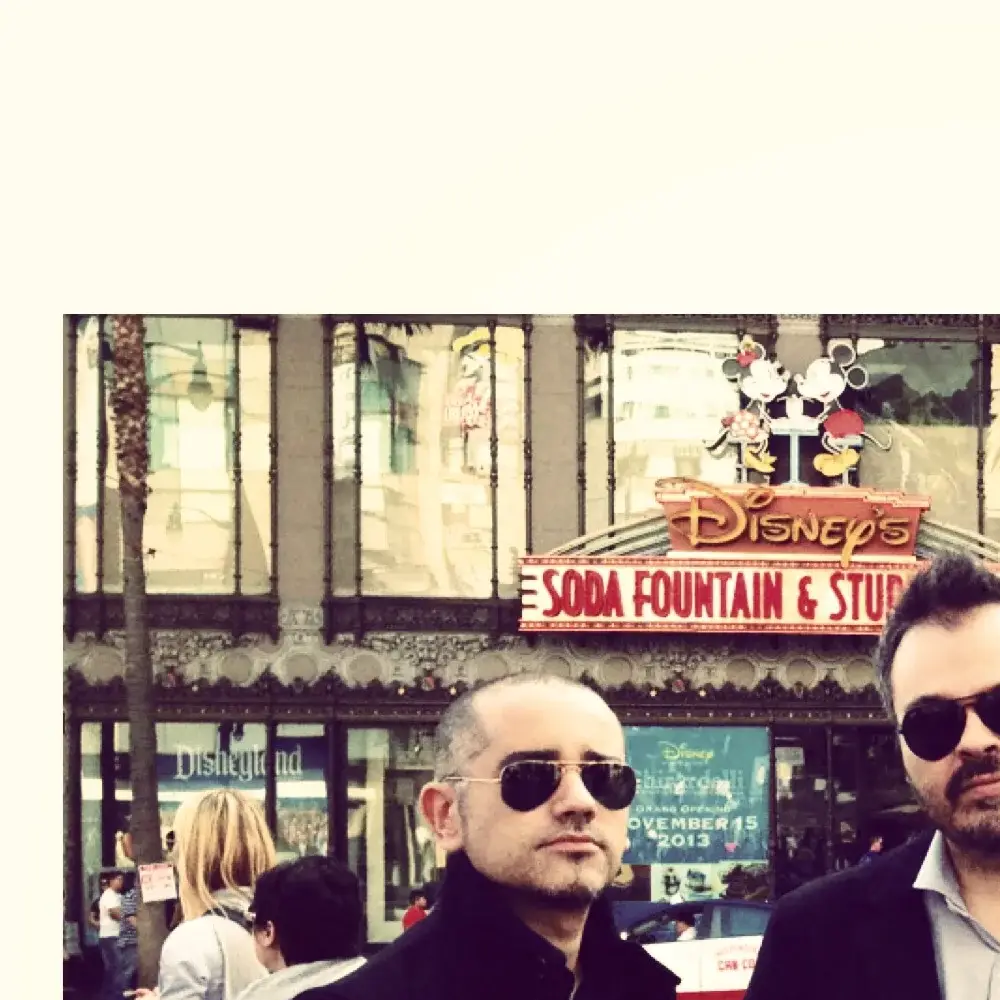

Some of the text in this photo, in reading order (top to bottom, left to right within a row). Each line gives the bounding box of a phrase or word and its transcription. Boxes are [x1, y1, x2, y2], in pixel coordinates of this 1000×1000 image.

[542, 569, 904, 621] SODA FOUNTAIN & STUD
[628, 815, 759, 830] OVEMBER 15
[658, 833, 711, 848] 2013
